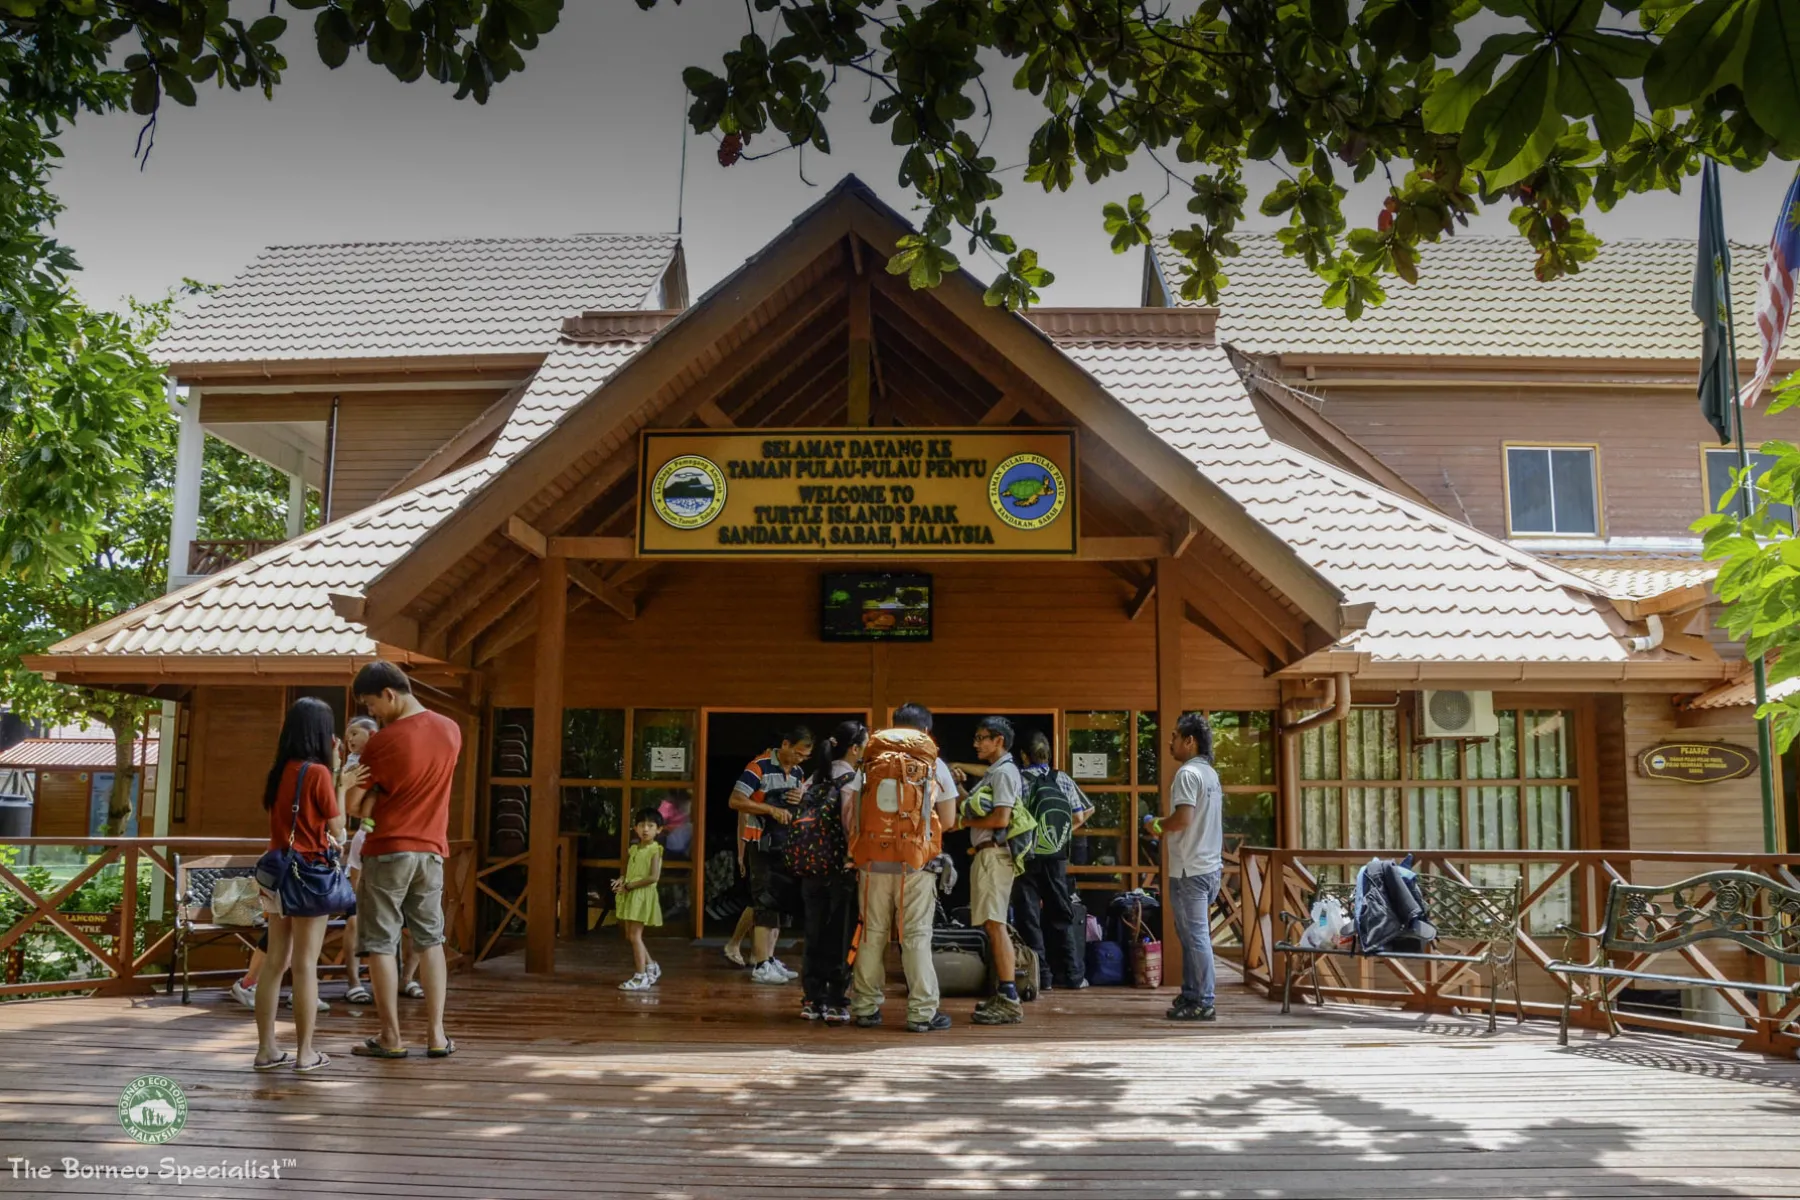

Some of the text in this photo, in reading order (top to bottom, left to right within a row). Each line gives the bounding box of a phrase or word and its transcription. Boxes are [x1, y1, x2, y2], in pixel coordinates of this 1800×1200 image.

[762, 440, 952, 458] SELAMAT DATANG KE
[727, 460, 987, 478] TAMAN PULAU-PULAU PENYU
[798, 485, 914, 504] WELCOME TO
[754, 505, 959, 524] TURTLE ISLANDS PARK
[718, 526, 995, 548] SANDAKAN, SABAH, MALAYSIA
[62, 914, 107, 923] LANCONG
